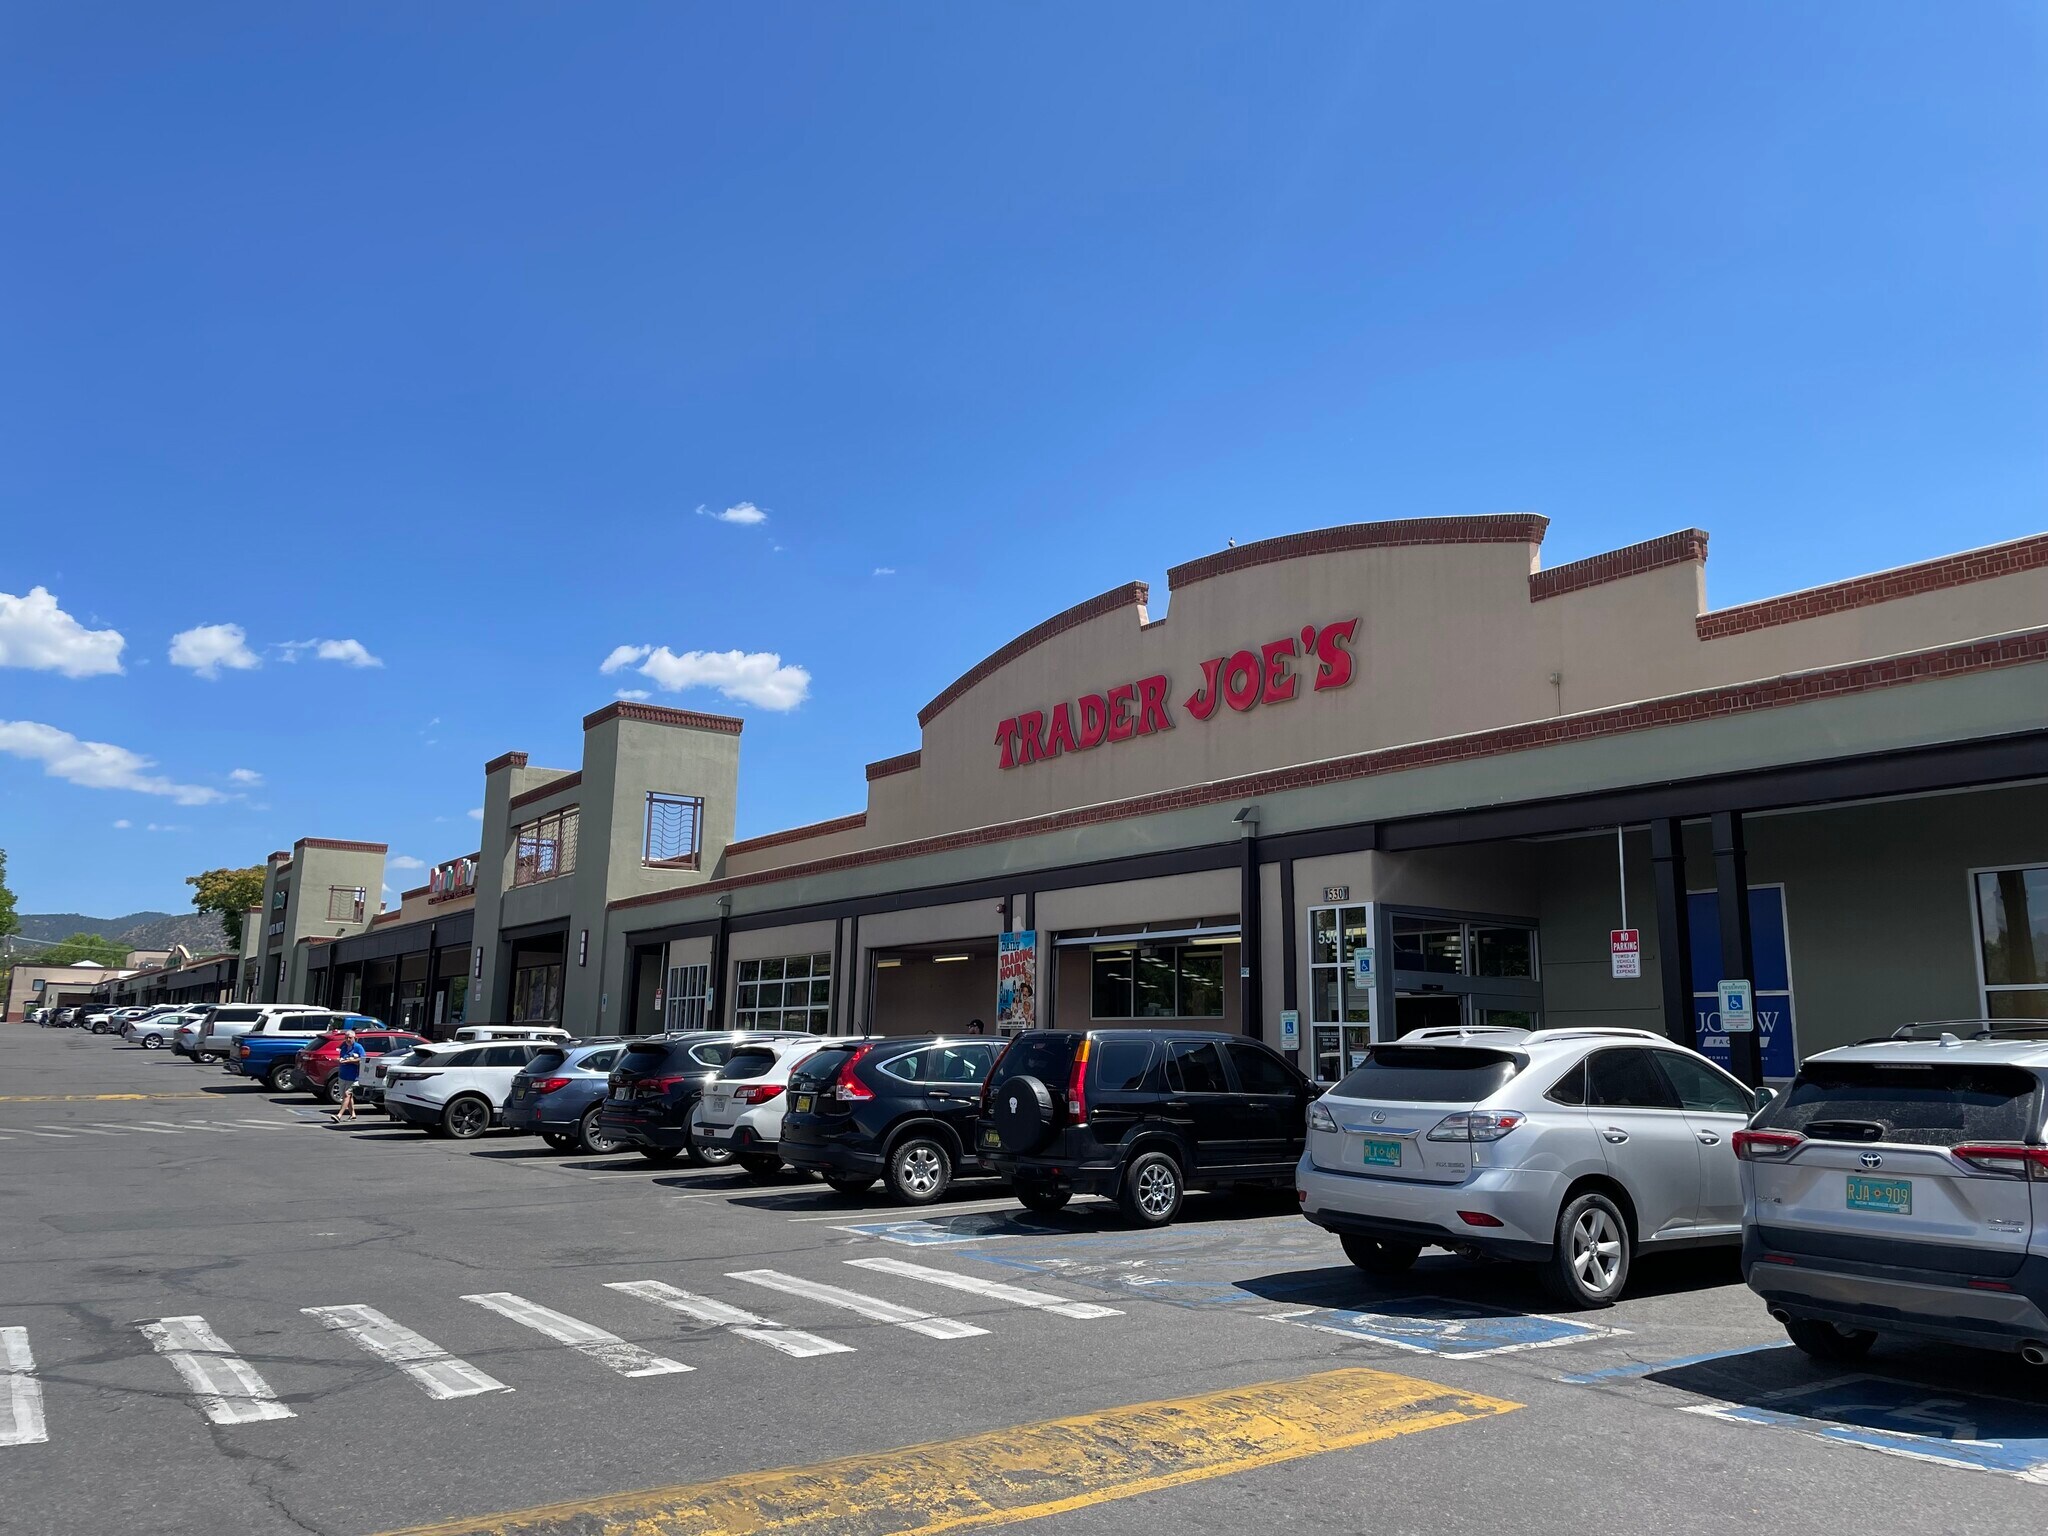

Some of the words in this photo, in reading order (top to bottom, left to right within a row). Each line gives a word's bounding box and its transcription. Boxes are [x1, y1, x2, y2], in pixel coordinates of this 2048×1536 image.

[994, 674, 1176, 769] TRADER
[1183, 617, 1362, 721] JOE'S
[1328, 888, 1344, 900] 530
[1613, 941, 1637, 951] PARKING
[1620, 932, 1629, 942] NO
[1000, 946, 1034, 967] TRADING
[999, 963, 1026, 981] HOURS
[1696, 1012, 1779, 1033] J.CW
[1848, 1184, 1869, 1201] RJA
[1886, 1187, 1908, 1204] 909
